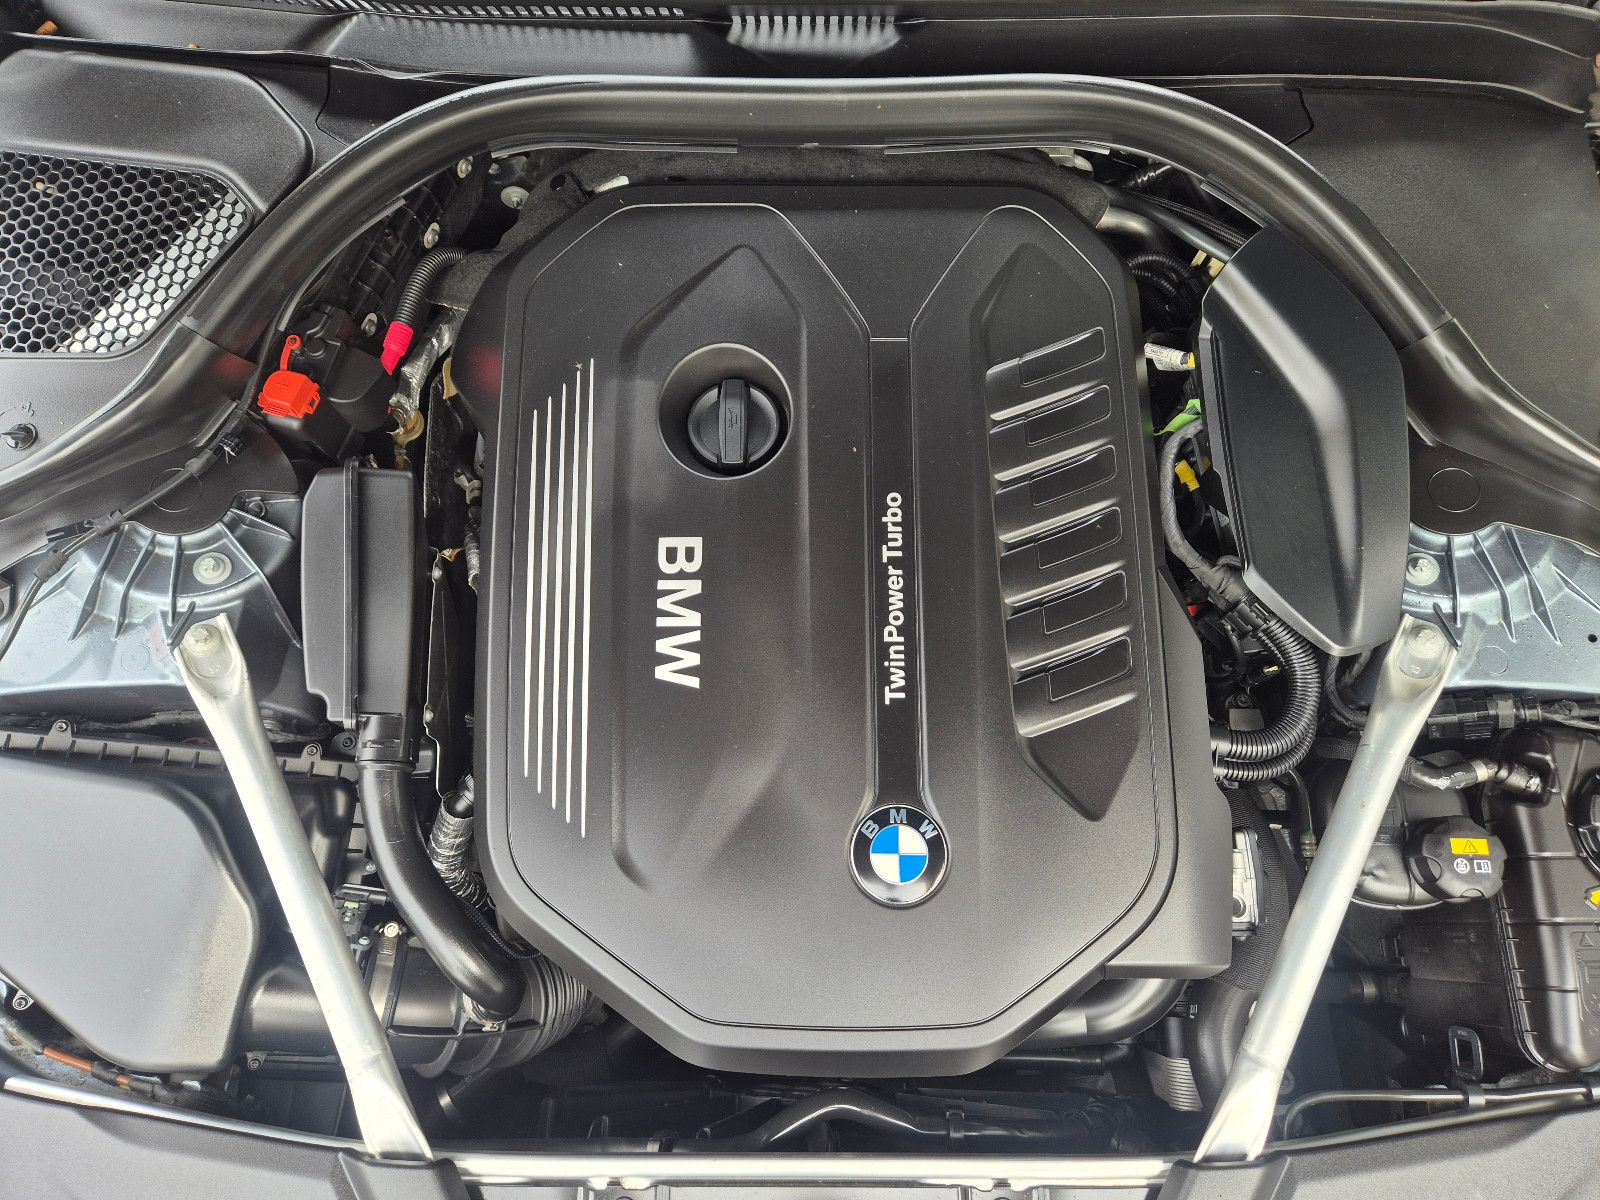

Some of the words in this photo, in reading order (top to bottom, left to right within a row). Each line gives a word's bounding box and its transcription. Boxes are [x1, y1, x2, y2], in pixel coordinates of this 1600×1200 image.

[882, 492, 903, 563] Turbo
[655, 536, 703, 689] BMW
[884, 566, 906, 705] TwinPower
[860, 808, 939, 840] BMW
